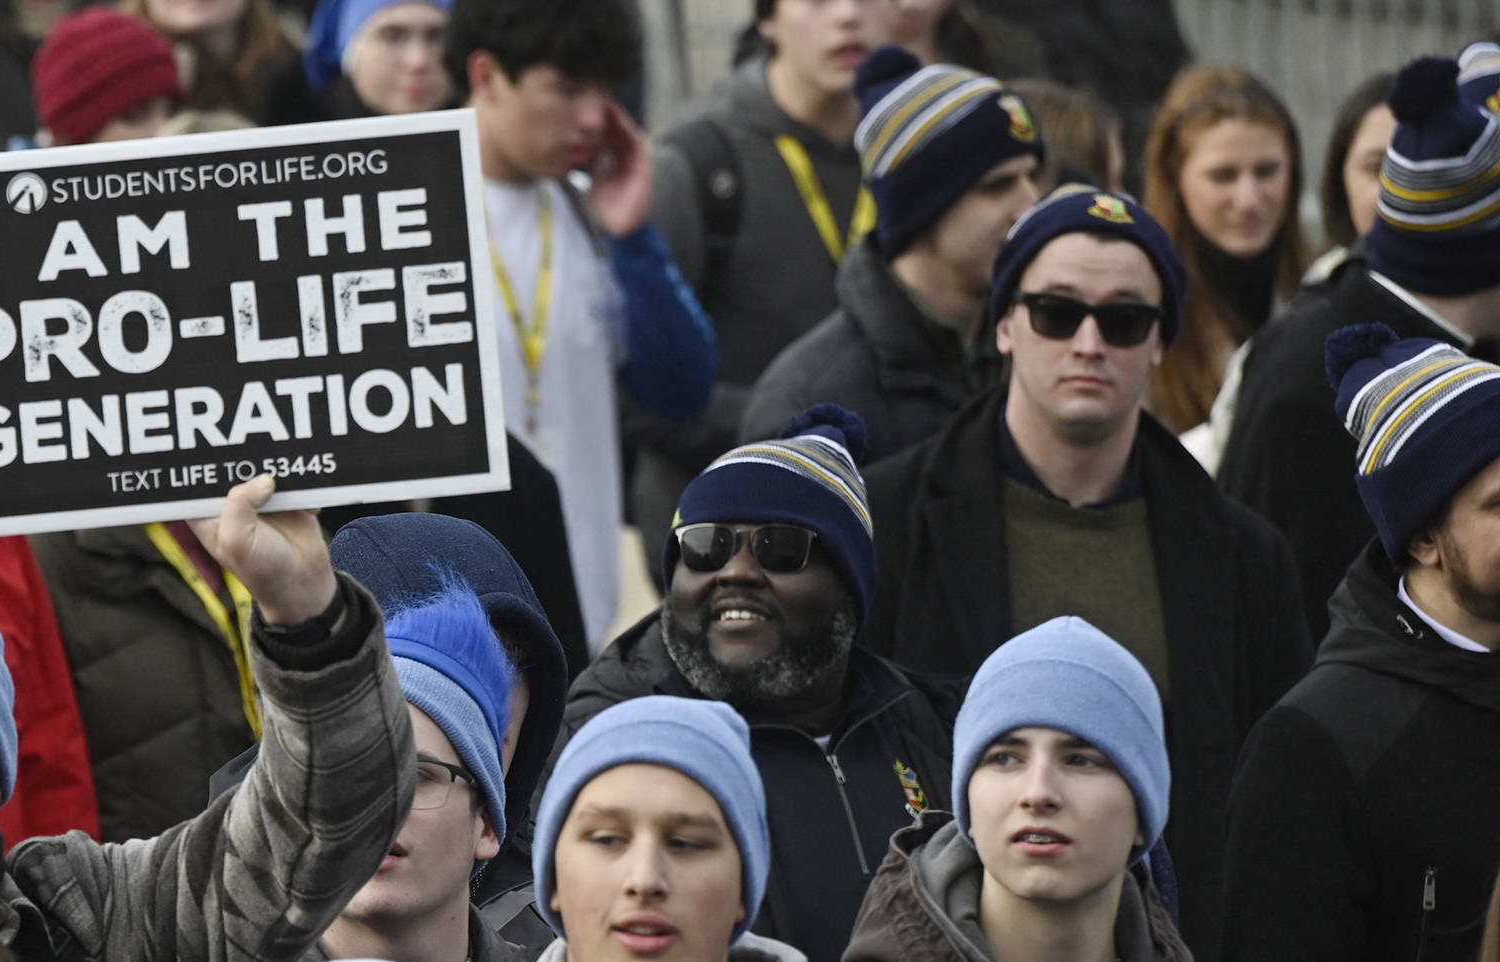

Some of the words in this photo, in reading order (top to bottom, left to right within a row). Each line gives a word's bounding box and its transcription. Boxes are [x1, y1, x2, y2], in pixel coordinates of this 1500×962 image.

[51, 149, 389, 204] STUDENTSFORLIFE.ORG
[37, 210, 191, 282] AM
[237, 188, 432, 262] THE
[107, 468, 163, 493] TEXT
[169, 463, 218, 488] LIFE
[223, 460, 256, 483] TO
[262, 453, 337, 479] 53445
